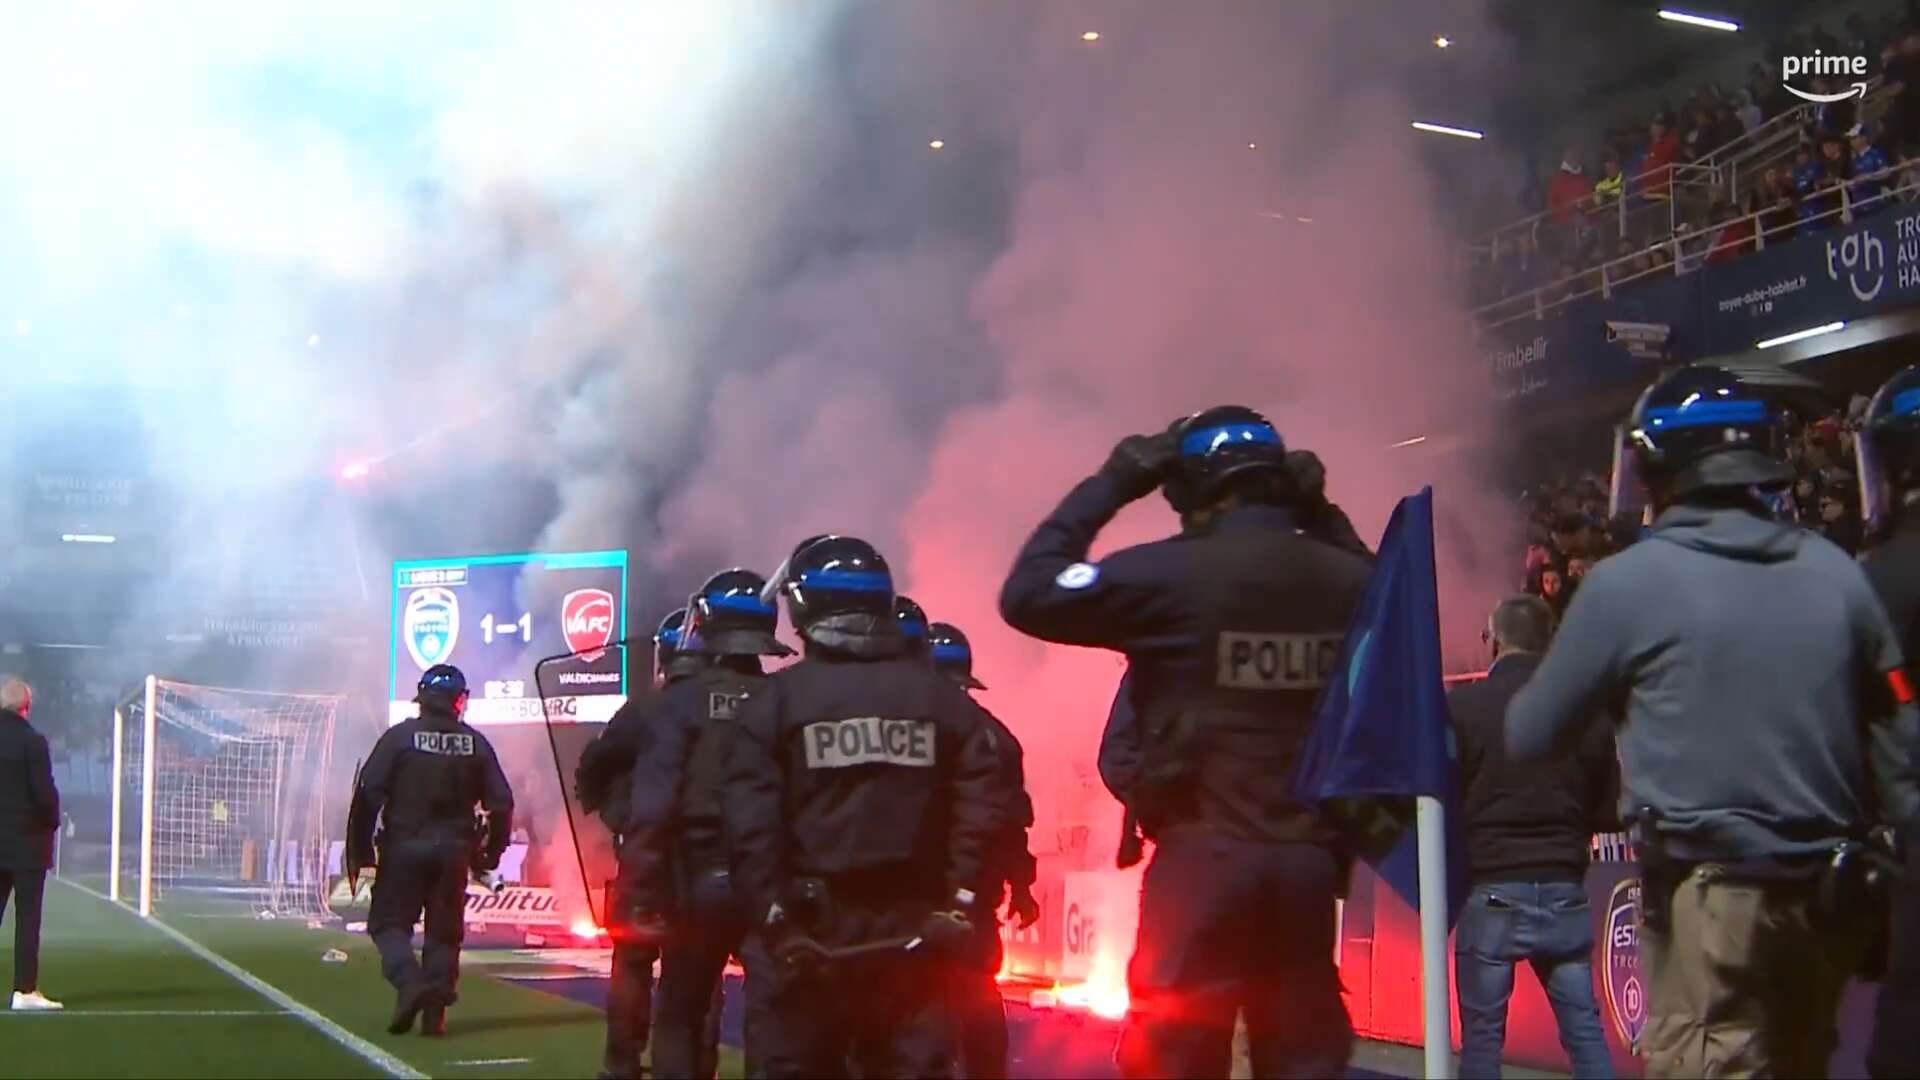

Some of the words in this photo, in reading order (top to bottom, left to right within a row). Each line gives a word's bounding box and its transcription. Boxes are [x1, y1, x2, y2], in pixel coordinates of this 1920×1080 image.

[566, 615, 610, 634] VAFC
[417, 734, 470, 752] POLICE
[815, 723, 927, 759] POLICE
